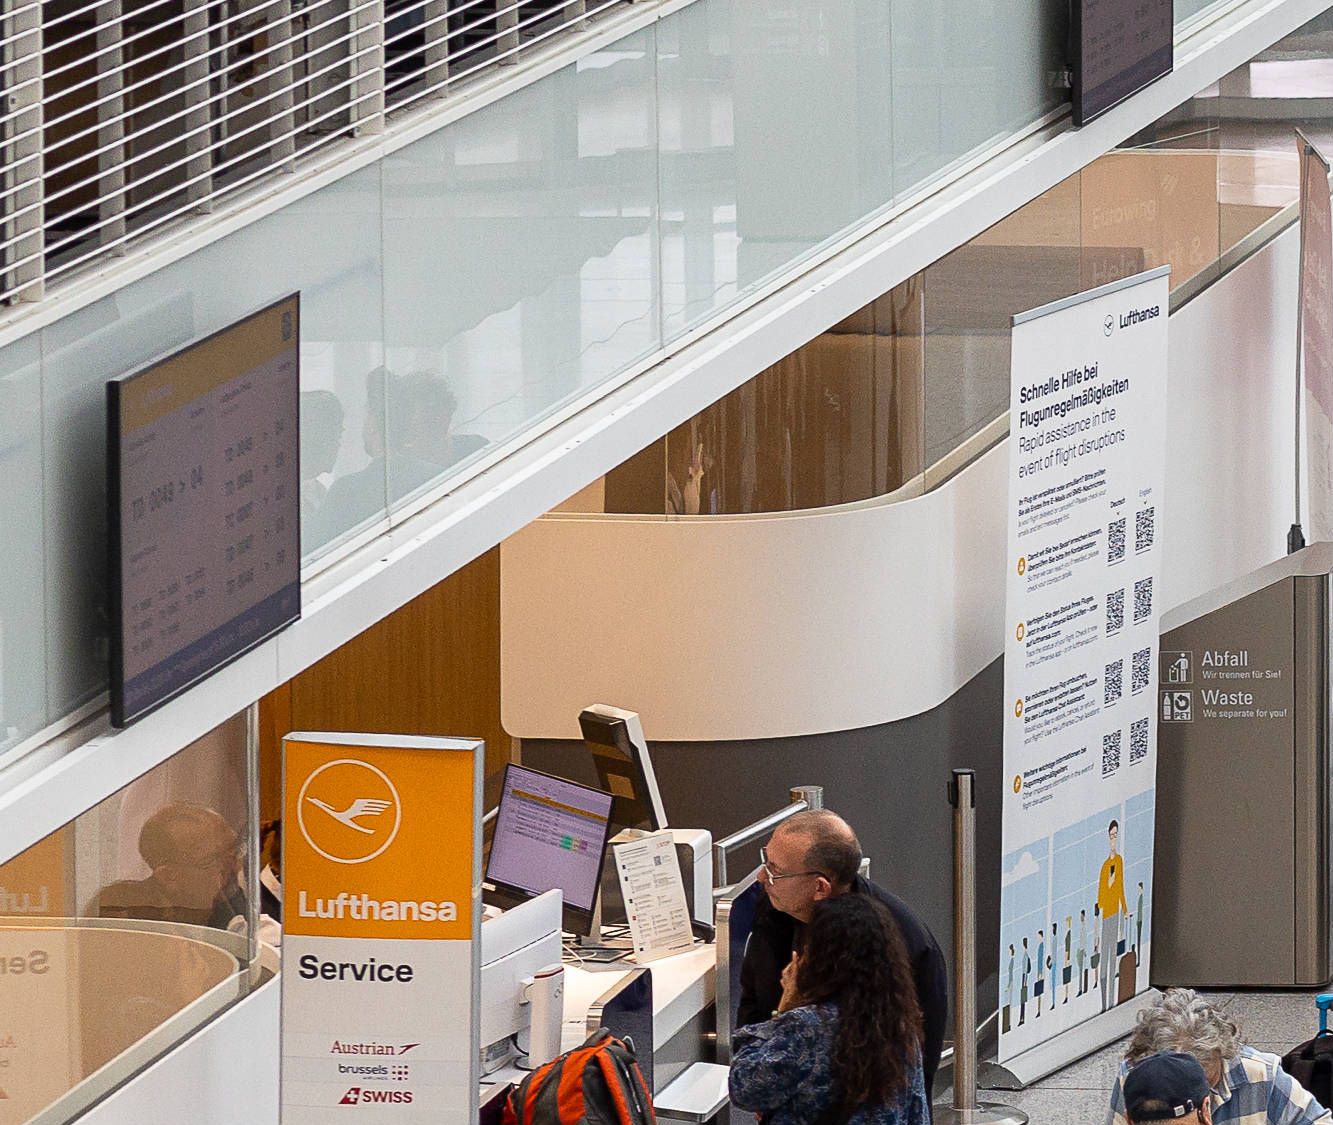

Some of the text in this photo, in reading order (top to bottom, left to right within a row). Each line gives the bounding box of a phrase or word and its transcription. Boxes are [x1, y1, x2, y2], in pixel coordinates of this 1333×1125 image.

[1119, 304, 1160, 330] Lufthansa
[1020, 362, 1098, 404] Schnelle Hilfe bei
[1020, 377, 1129, 429] Flugunregelmäßigkeiten
[1019, 407, 1116, 456] Rapid assistance in the
[1018, 428, 1126, 479] event of flight disruptions
[1202, 651, 1248, 667] Abfall
[1202, 671, 1216, 679] Wir
[1218, 671, 1250, 679] trennen
[1252, 670, 1264, 679] für
[1202, 689, 1253, 705] Waste
[1203, 708, 1287, 720] We separate for you!
[298, 890, 457, 922] Lufthansa
[299, 955, 414, 983] Service
[331, 1041, 395, 1056] Austrian
[338, 1064, 388, 1075] brussels
[362, 1091, 413, 1103] SWISS
